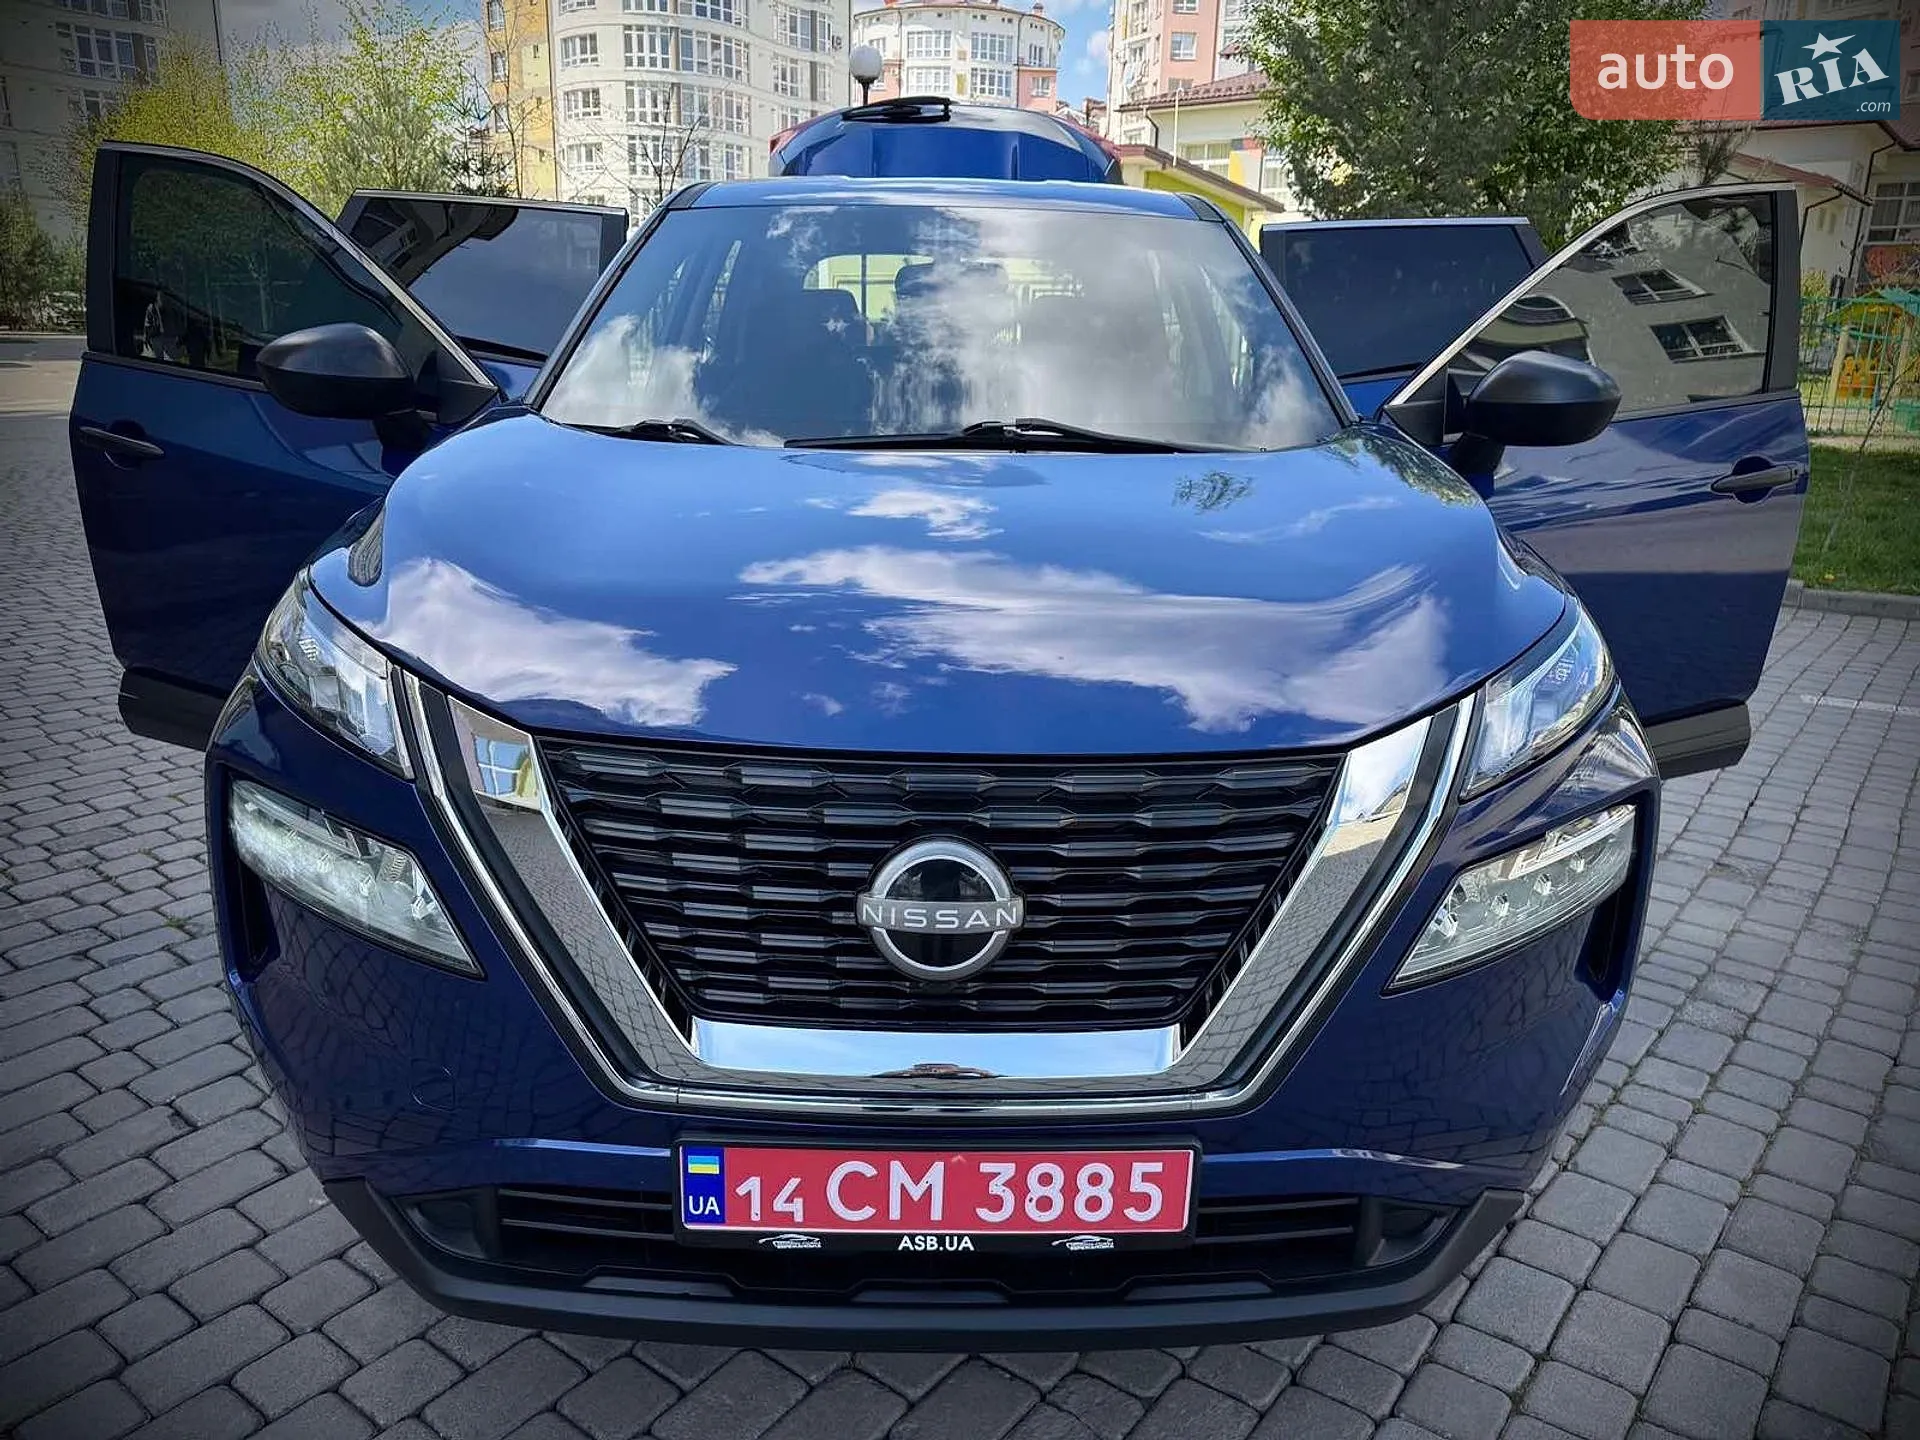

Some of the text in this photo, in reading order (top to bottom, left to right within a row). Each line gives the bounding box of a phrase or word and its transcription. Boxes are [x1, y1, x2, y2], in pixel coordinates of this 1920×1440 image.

[862, 904, 1017, 929] NISSAN
[735, 1160, 1164, 1223] 14 CM 3885
[689, 1196, 720, 1215] UA
[898, 1235, 975, 1251] ASB.UA
